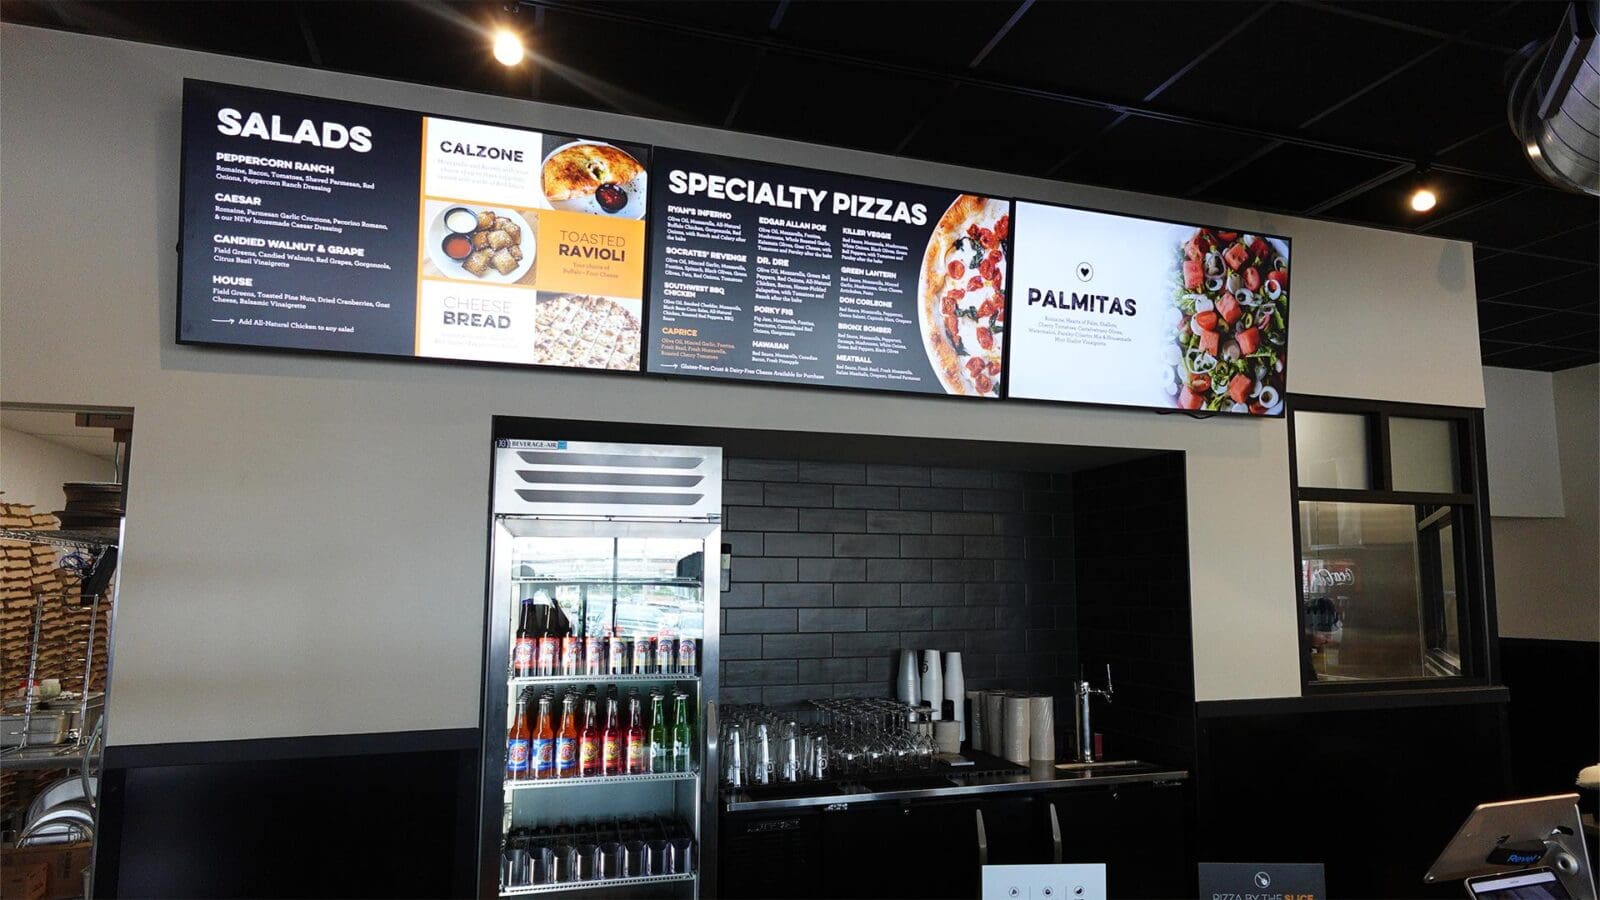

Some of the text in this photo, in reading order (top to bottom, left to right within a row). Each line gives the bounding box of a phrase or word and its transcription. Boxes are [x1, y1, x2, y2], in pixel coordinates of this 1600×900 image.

[218, 107, 372, 154] SALADS
[440, 140, 524, 163] CALZONE
[217, 152, 334, 175] PEPPERCORN RANCH
[216, 173, 331, 192] Onions, Peppercorn Ranch Dressing
[217, 165, 375, 190] Romaine, Bacon, Tomatoes, Shaved Parmesan, Red
[216, 193, 261, 206] CAESAR
[668, 169, 928, 225] SPECIALTY PIZZAS
[215, 206, 388, 230] Romaine, Parmesan Garlic Croutons, Pecorino Romano,
[668, 205, 732, 220] RYAN'S INFERNO
[221, 214, 233, 222] our
[234, 216, 252, 224] NEW
[253, 218, 290, 227] housemade
[291, 221, 313, 230] Caesar
[315, 224, 342, 233] Dressing
[759, 217, 827, 232] EDGAR ALLAN POE
[560, 230, 626, 248] TOASTED
[843, 228, 892, 240] KILLER VEGGIE
[215, 235, 365, 257] CANDIED WALNUT & GRAPE
[559, 244, 625, 262] RAVIOLI
[214, 247, 231, 255] Field
[232, 249, 257, 258] Greens,
[258, 251, 285, 260] Candied
[287, 254, 315, 263] Walnuts,
[329, 258, 353, 266] Grapes,
[354, 260, 391, 270] Gorgonzola,
[214, 255, 290, 268] Citrus Basil Vinaigrette
[711, 252, 747, 262] REVENGE
[757, 256, 789, 267] DR. DRE
[841, 266, 897, 279] GREEN LANTERN
[213, 276, 253, 287] HOUSE
[664, 282, 725, 294] SOUTHWEST BBQ
[213, 288, 230, 296] Field
[231, 290, 256, 298] Greens,
[257, 292, 283, 300] Toasted
[284, 294, 299, 302] Pine
[300, 295, 317, 303] Nuts,
[337, 298, 374, 307] Cranberries,
[376, 301, 390, 309] Goat
[664, 289, 696, 298] CHICKEN
[213, 296, 307, 310] Cheese, Balsamic Vinaigrette
[444, 296, 512, 314] CHEESE
[856, 298, 893, 308] CORLEONE
[1028, 288, 1137, 317] PALMITAS
[754, 305, 793, 316] PORKY FIG
[253, 320, 289, 329] All-Natural
[290, 322, 317, 330] Chicken
[443, 311, 511, 329] BREAD
[662, 327, 698, 337] CAPRICE
[838, 323, 892, 334] BRONX BOMBER
[752, 341, 789, 350] HAWAIIAN
[836, 354, 872, 364] MEATBALL
